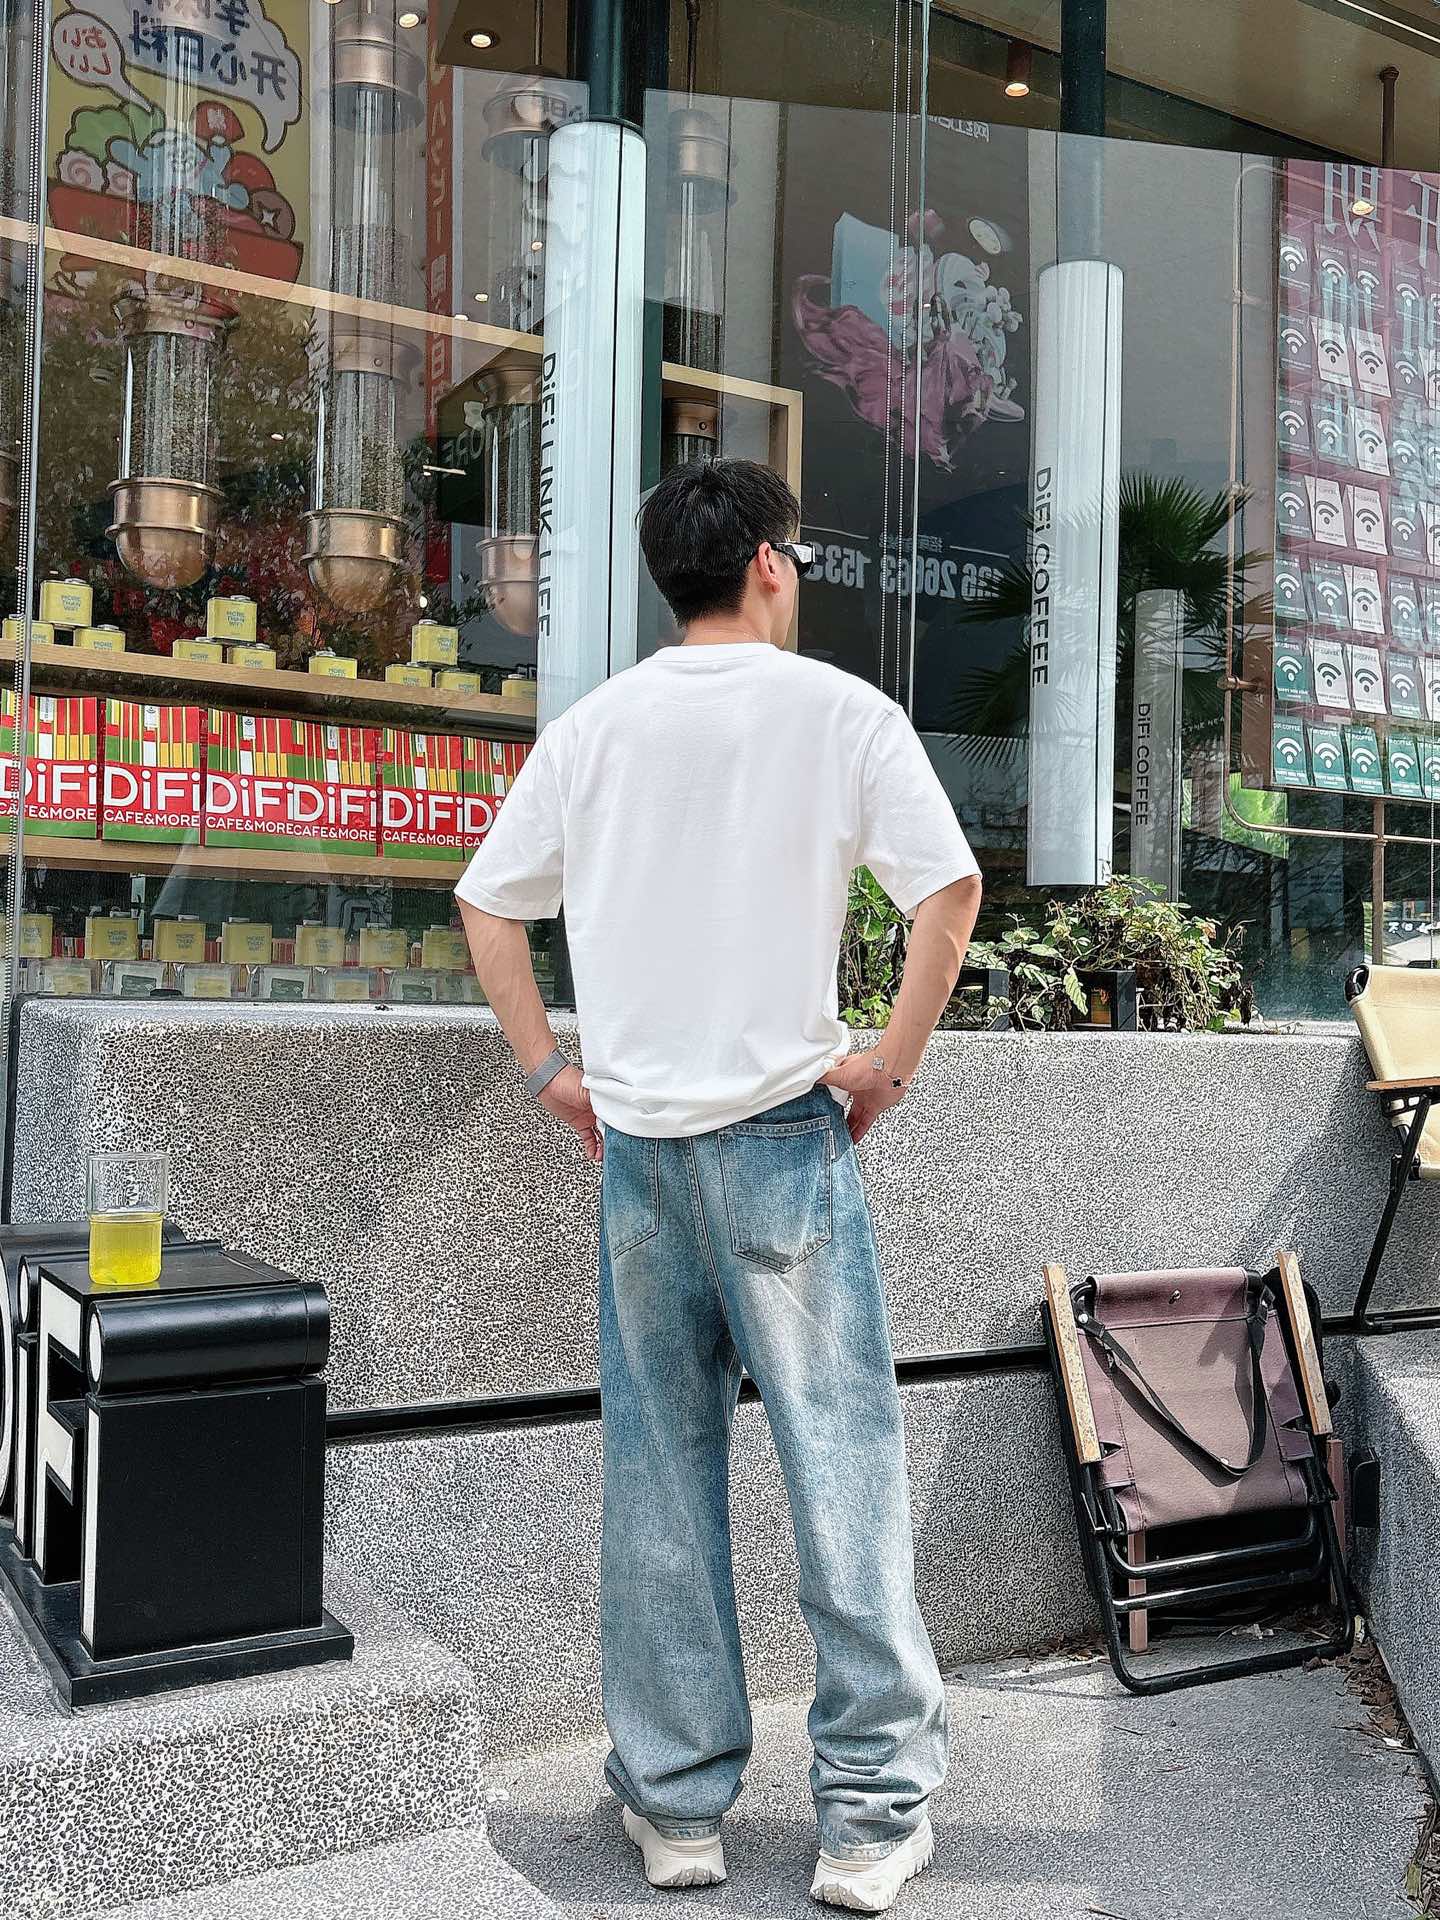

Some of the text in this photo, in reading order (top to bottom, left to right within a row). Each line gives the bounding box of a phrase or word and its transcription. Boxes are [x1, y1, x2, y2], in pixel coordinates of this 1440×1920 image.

[541, 352, 556, 428] DiFi
[1031, 467, 1051, 689] DiFi COFFEE
[104, 764, 200, 811] DiFi
[1135, 703, 1151, 826] DiFi COFFEE
[104, 808, 200, 827] CAFE&MORE
[206, 773, 294, 820] DiFi
[293, 782, 377, 828] DiFi
[383, 790, 463, 833] DiFi
[206, 816, 295, 835] CAFE&MORE
[294, 825, 377, 842] CAFE&MORE
[383, 830, 463, 847] CAFE&MORE
